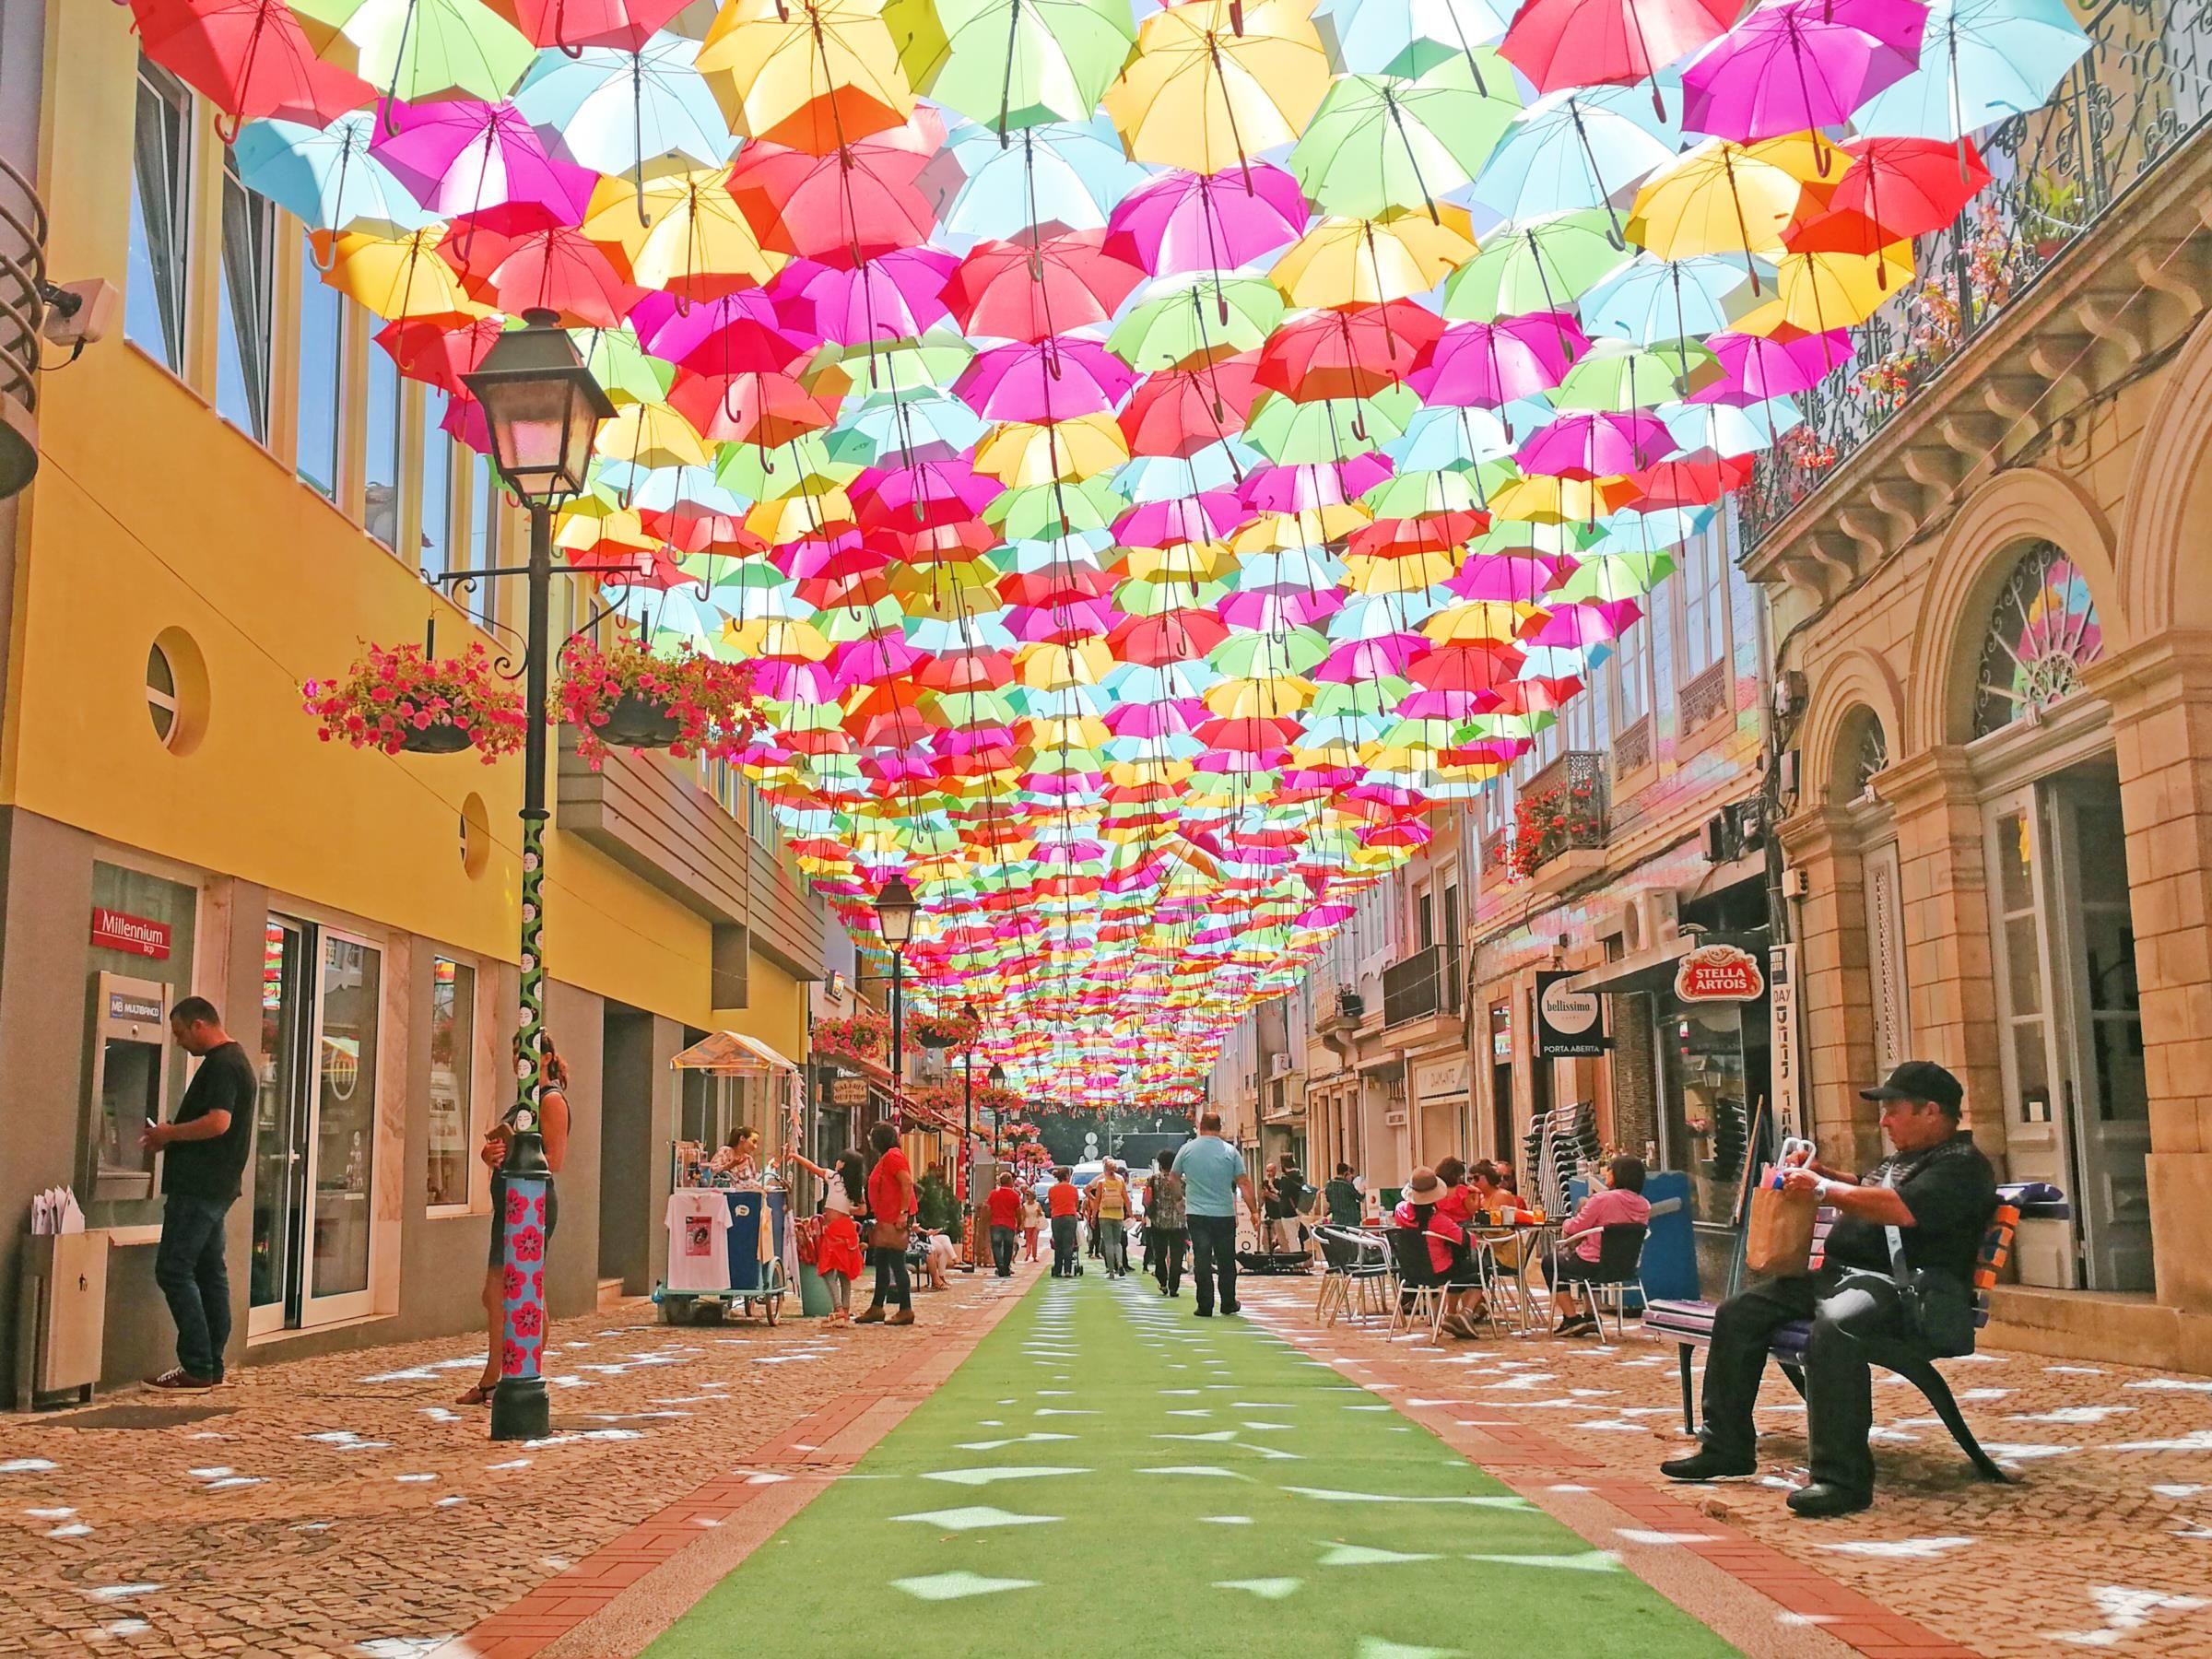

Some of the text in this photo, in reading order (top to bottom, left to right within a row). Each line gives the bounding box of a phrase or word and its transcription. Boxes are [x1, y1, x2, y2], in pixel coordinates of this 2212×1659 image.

[101, 909, 163, 945] Millennium
[143, 943, 155, 956] bcp
[1695, 968, 1747, 979] STELLA
[1696, 979, 1747, 989] ARTOIS
[111, 999, 159, 1018] MB MULTIBANCO
[1543, 1044, 1600, 1053] PORTA ABERTA
